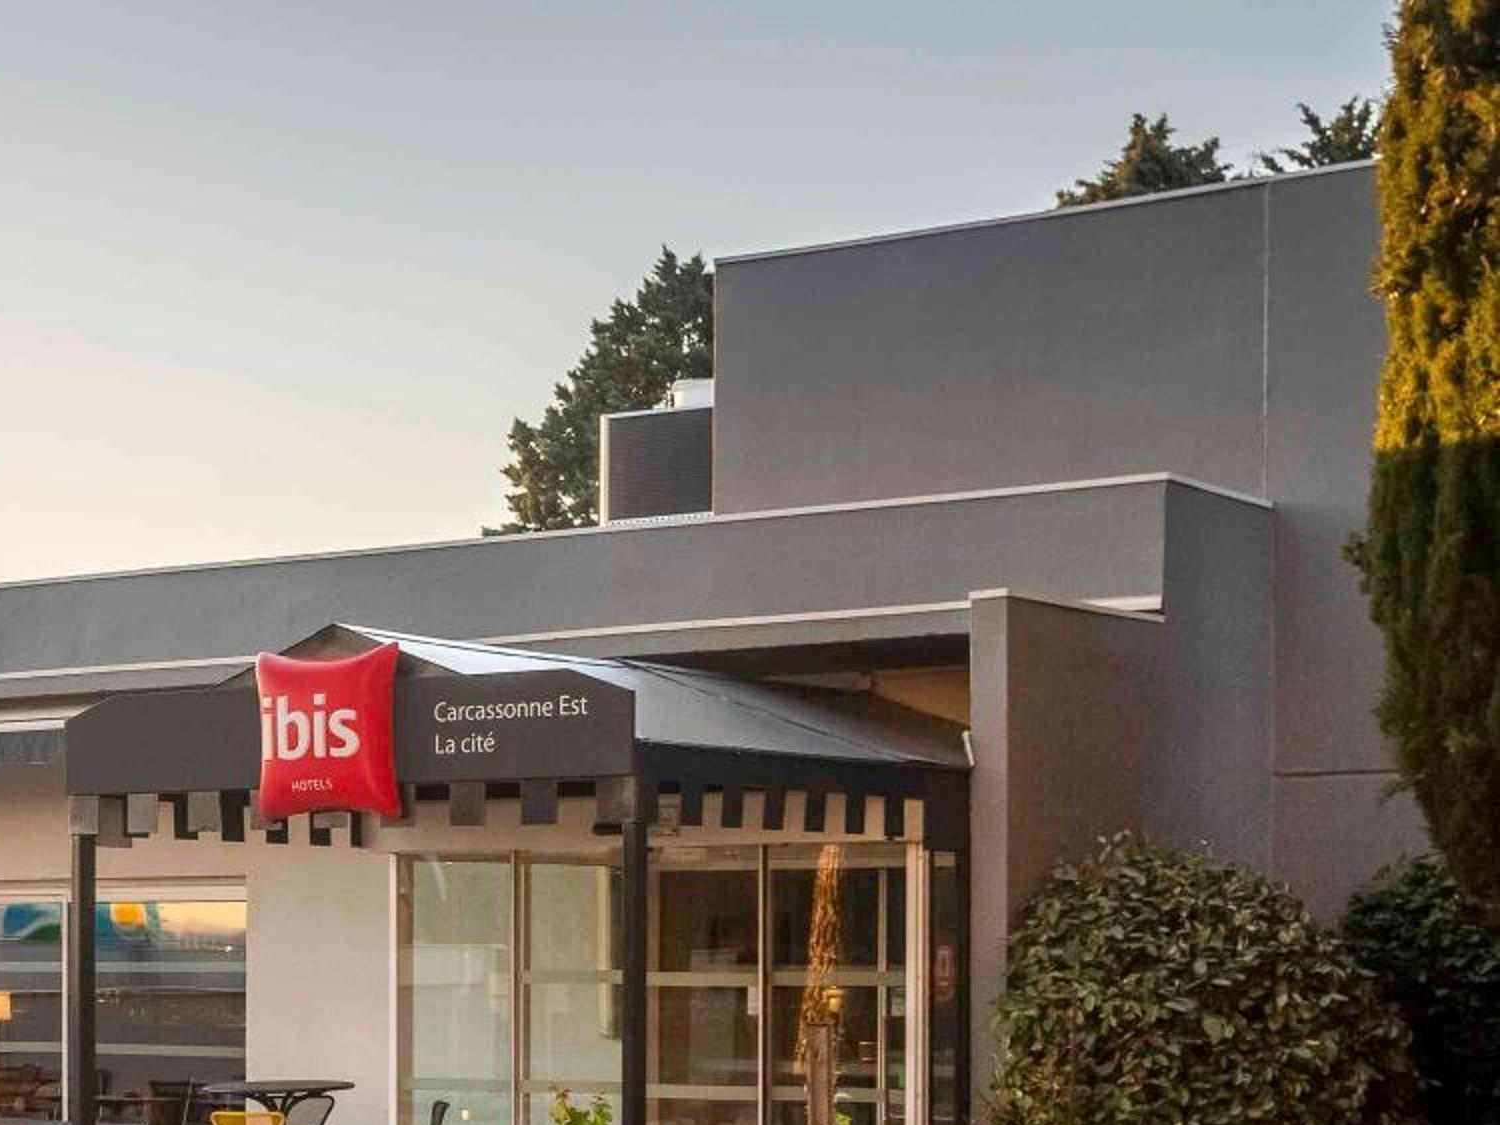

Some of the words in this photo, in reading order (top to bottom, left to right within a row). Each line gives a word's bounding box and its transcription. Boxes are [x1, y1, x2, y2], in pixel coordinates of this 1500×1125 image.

[433, 701, 553, 722] Carcassonne
[559, 695, 588, 715] Est
[261, 693, 360, 761] ibis
[435, 734, 455, 754] La
[461, 731, 495, 753] cité
[291, 778, 333, 792] HOTELS
